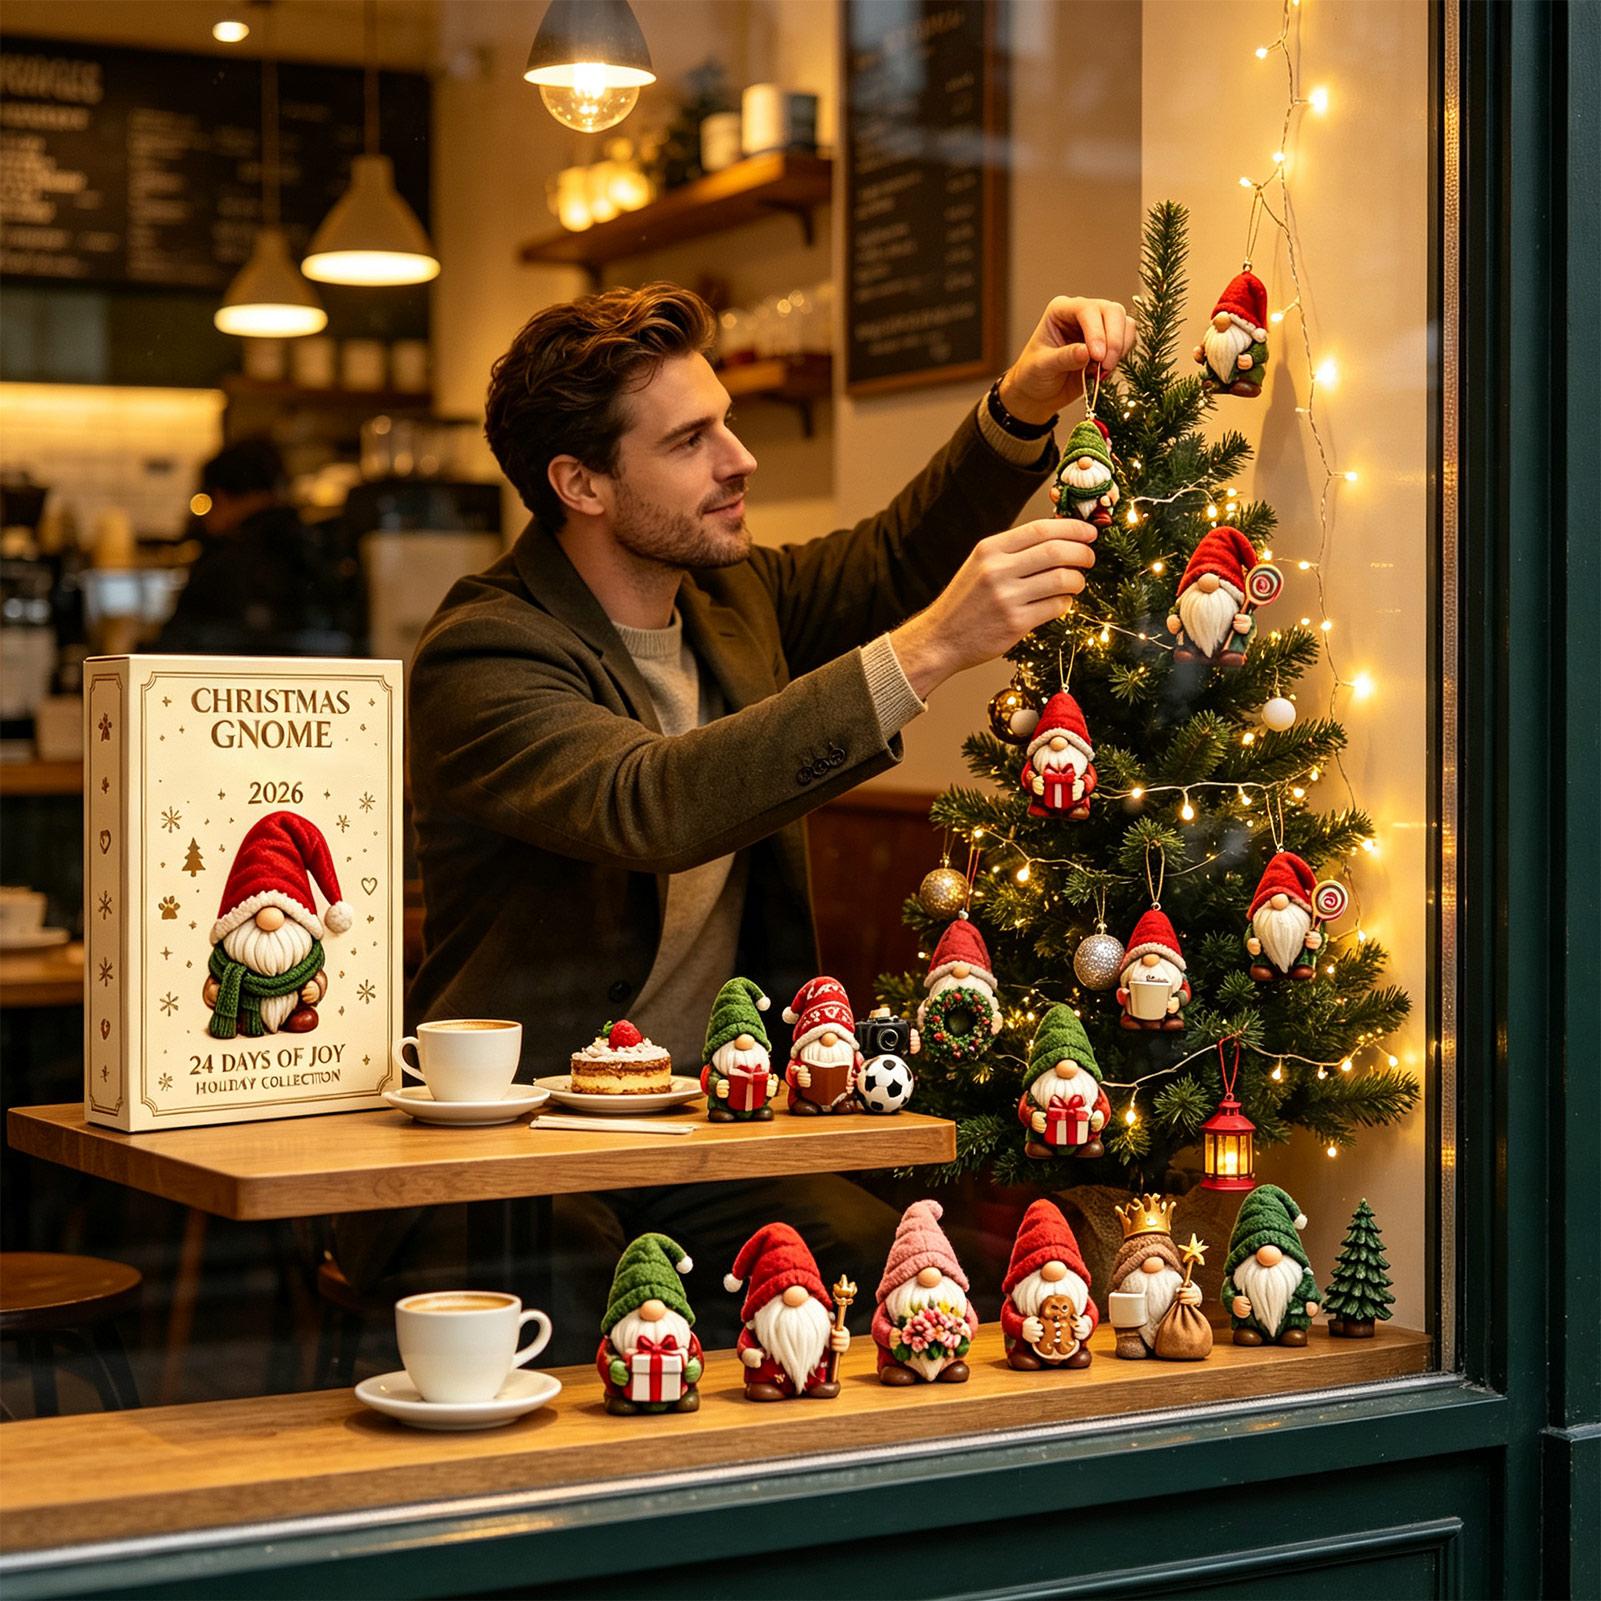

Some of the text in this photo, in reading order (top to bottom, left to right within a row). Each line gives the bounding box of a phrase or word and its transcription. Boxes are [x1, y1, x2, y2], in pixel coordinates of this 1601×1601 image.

[191, 687, 350, 714] CHRISTMAS
[211, 719, 333, 749] GNOME
[248, 781, 304, 804] 2026
[189, 1043, 346, 1075] 24 DAYS OF JOY
